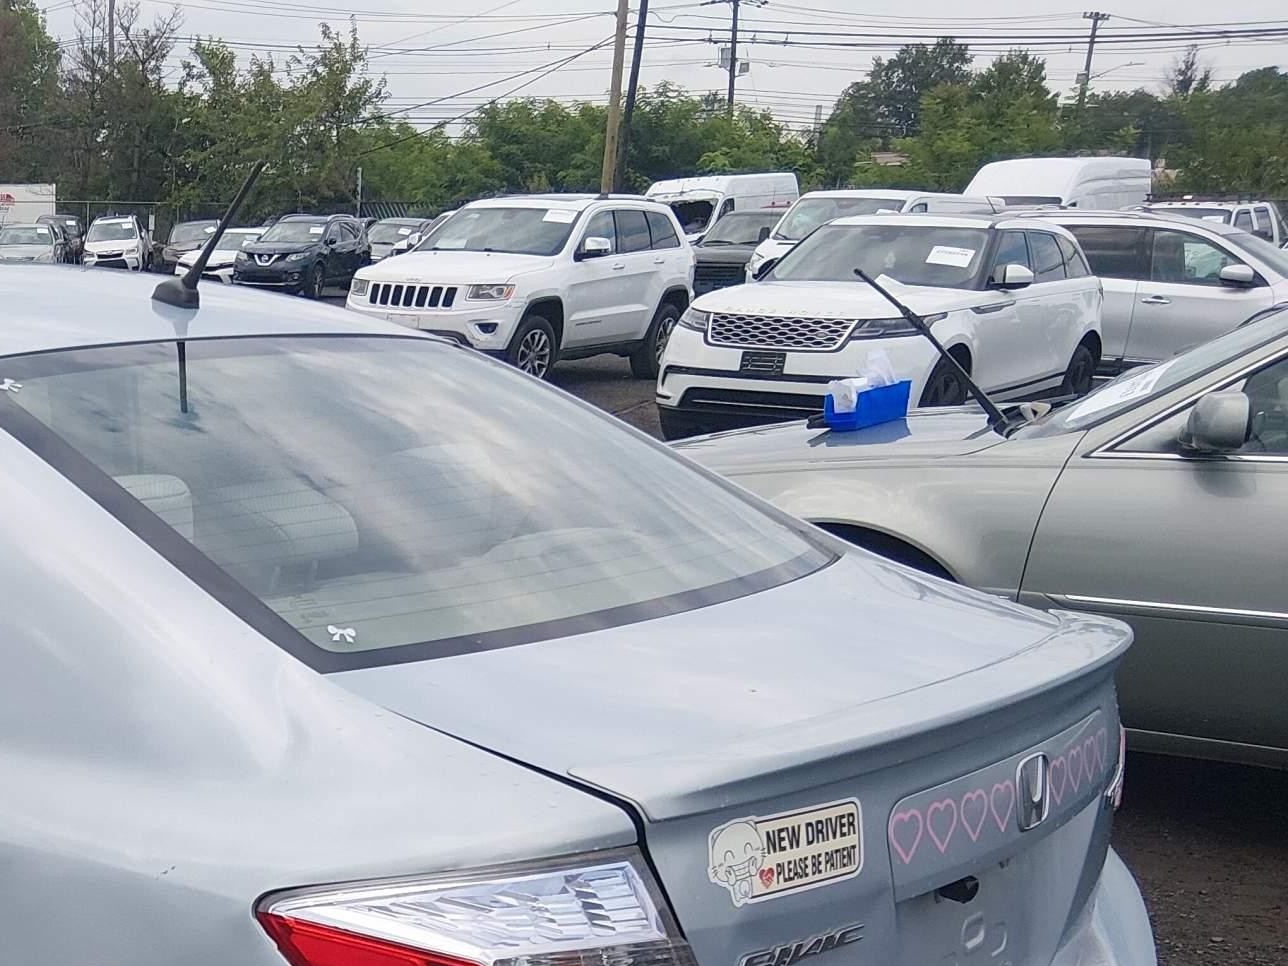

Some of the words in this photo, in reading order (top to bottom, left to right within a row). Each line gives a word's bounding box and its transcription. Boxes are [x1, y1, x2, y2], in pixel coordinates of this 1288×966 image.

[765, 824, 801, 855] NEW
[805, 812, 856, 846] DRIVER
[775, 856, 809, 885] PLEASE
[811, 853, 822, 876] BE
[824, 844, 857, 873] PATIENT
